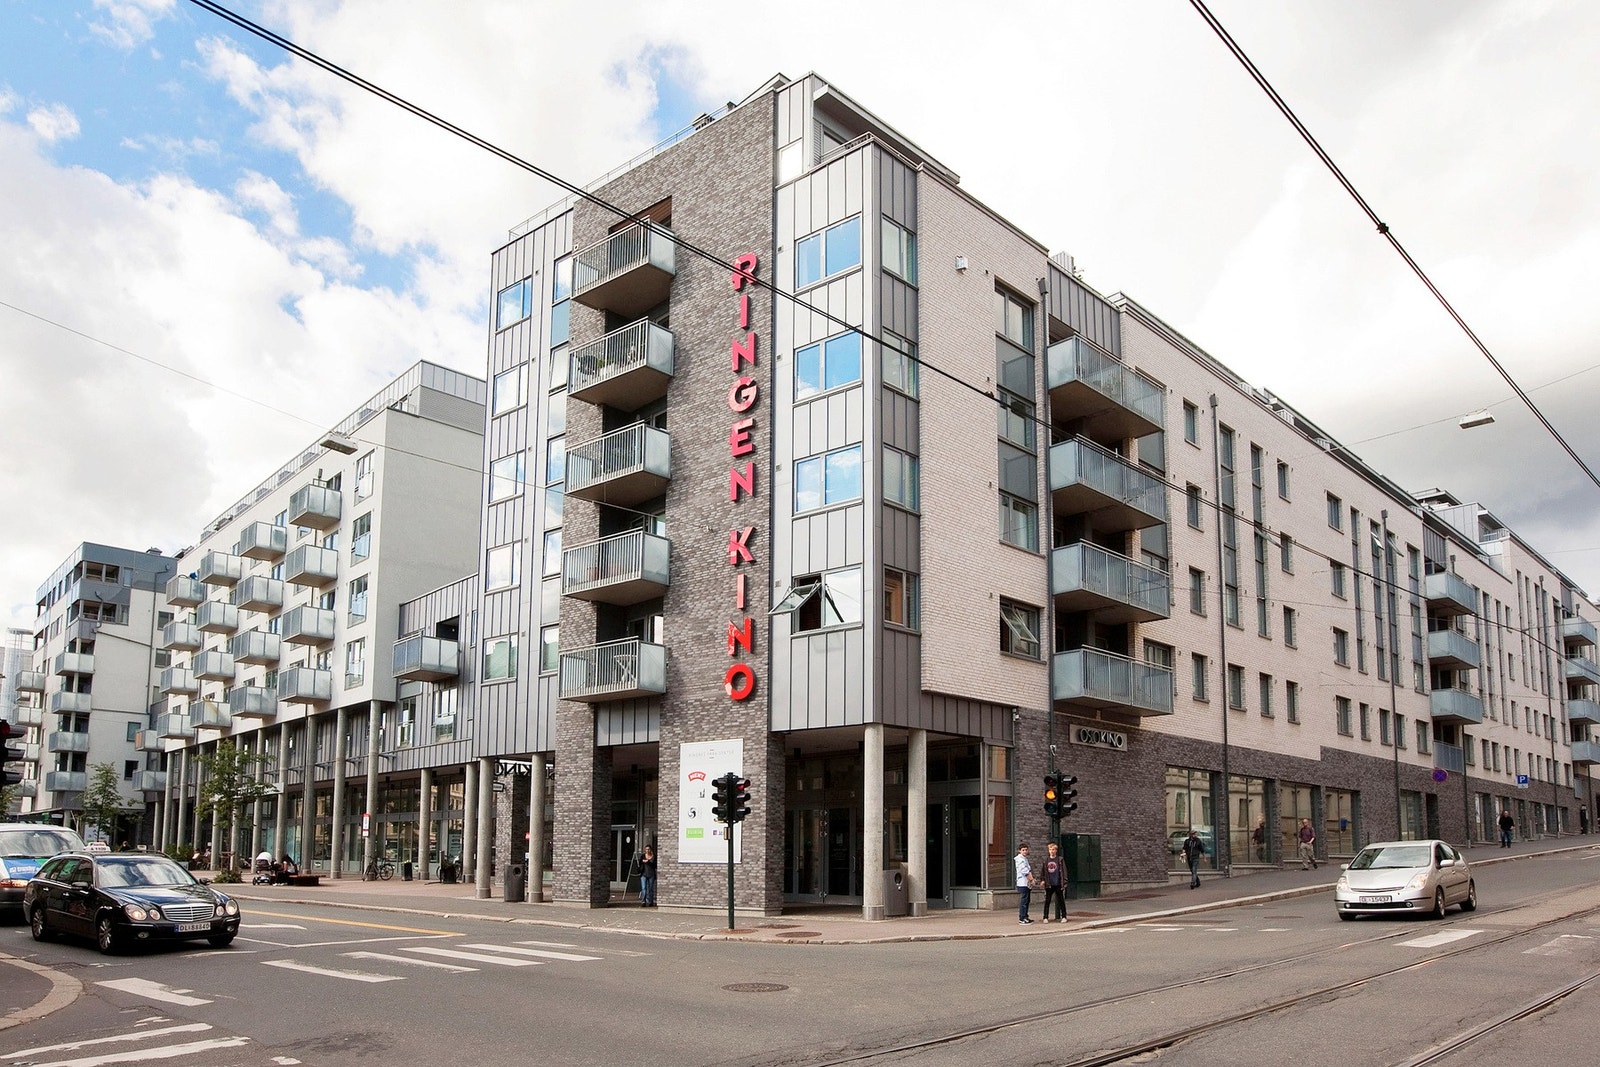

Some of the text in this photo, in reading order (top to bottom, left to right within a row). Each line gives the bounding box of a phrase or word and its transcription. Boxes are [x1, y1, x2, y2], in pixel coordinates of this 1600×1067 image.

[725, 252, 758, 700] RINGEN KINO
[1519, 775, 1526, 783] P
